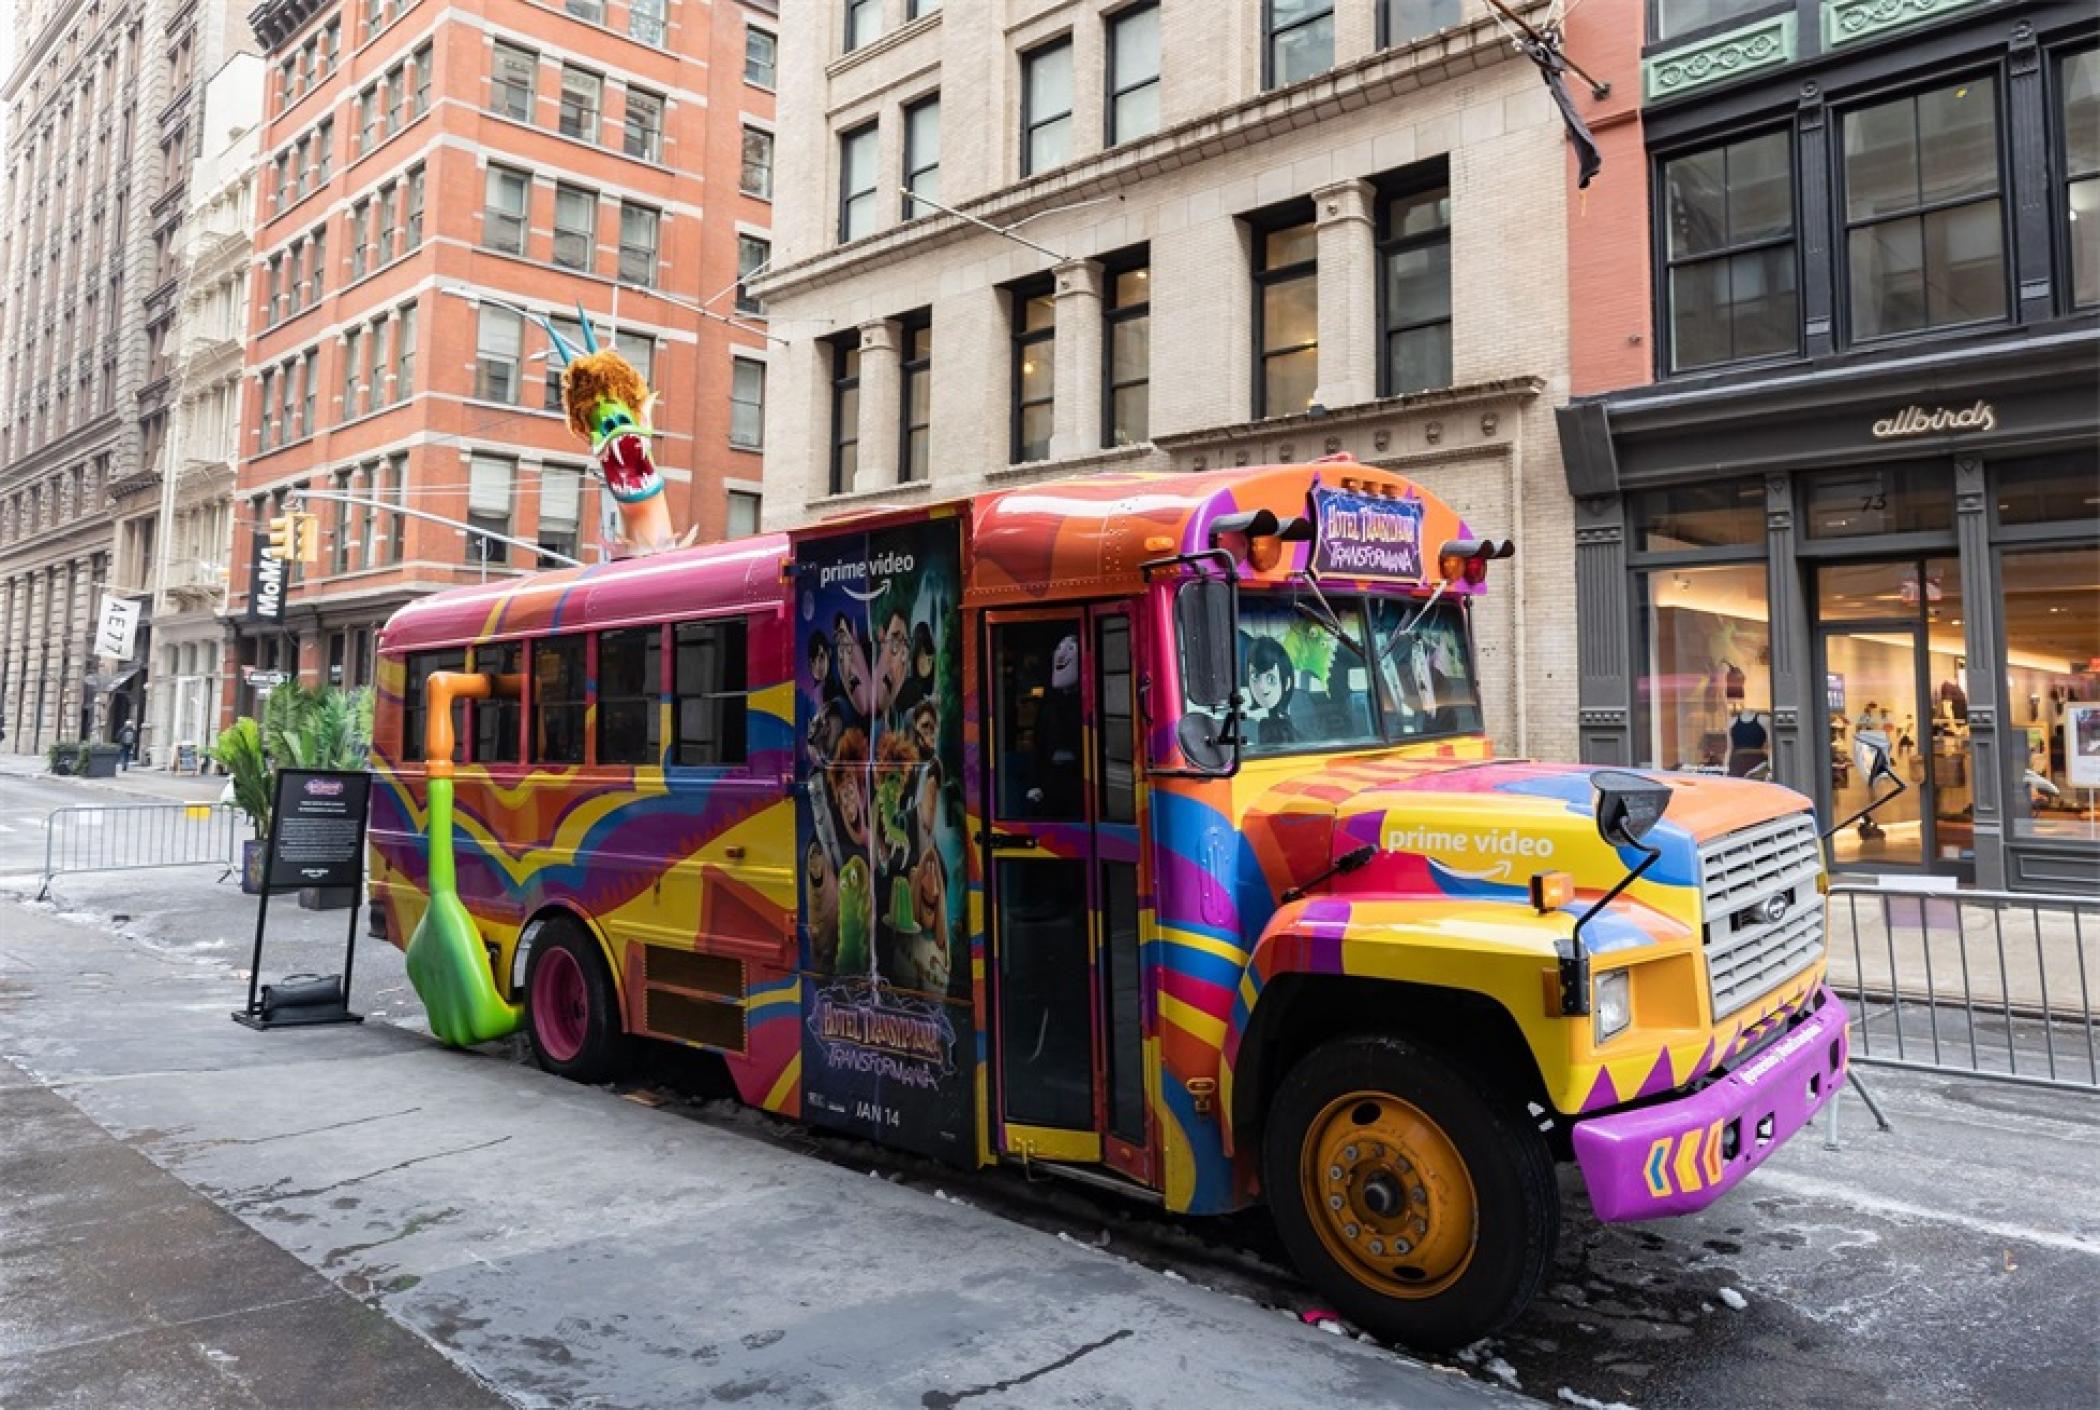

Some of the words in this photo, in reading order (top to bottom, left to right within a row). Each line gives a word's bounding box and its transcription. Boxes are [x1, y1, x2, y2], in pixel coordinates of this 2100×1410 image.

[1872, 400, 1995, 437] allbirds
[1862, 494, 1887, 512] 73
[820, 558, 866, 588] prime
[868, 551, 914, 575] video
[1387, 825, 1468, 854] prime
[1473, 828, 1554, 858] video
[856, 1101, 882, 1123] JAN
[885, 1107, 900, 1127] 14
